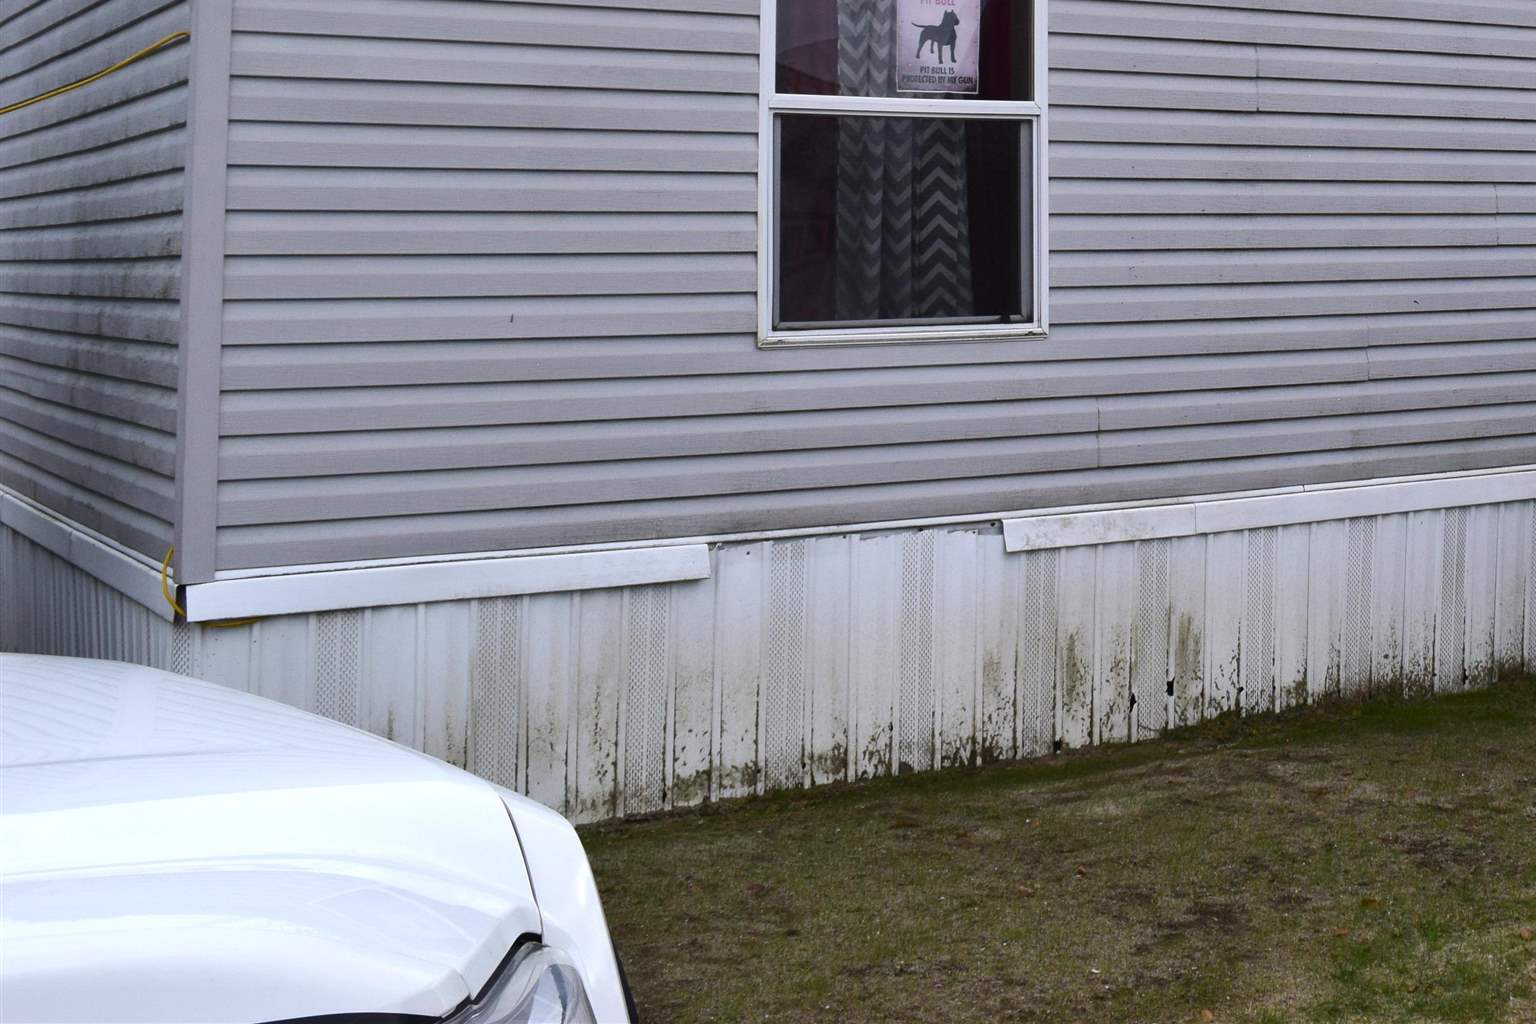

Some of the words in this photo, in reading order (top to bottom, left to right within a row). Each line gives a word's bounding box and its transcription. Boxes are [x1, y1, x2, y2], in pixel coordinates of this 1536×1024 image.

[920, 66, 930, 74] PIT
[931, 66, 946, 75] BULL
[948, 67, 955, 75] IS
[902, 74, 936, 84] PROTECTED
